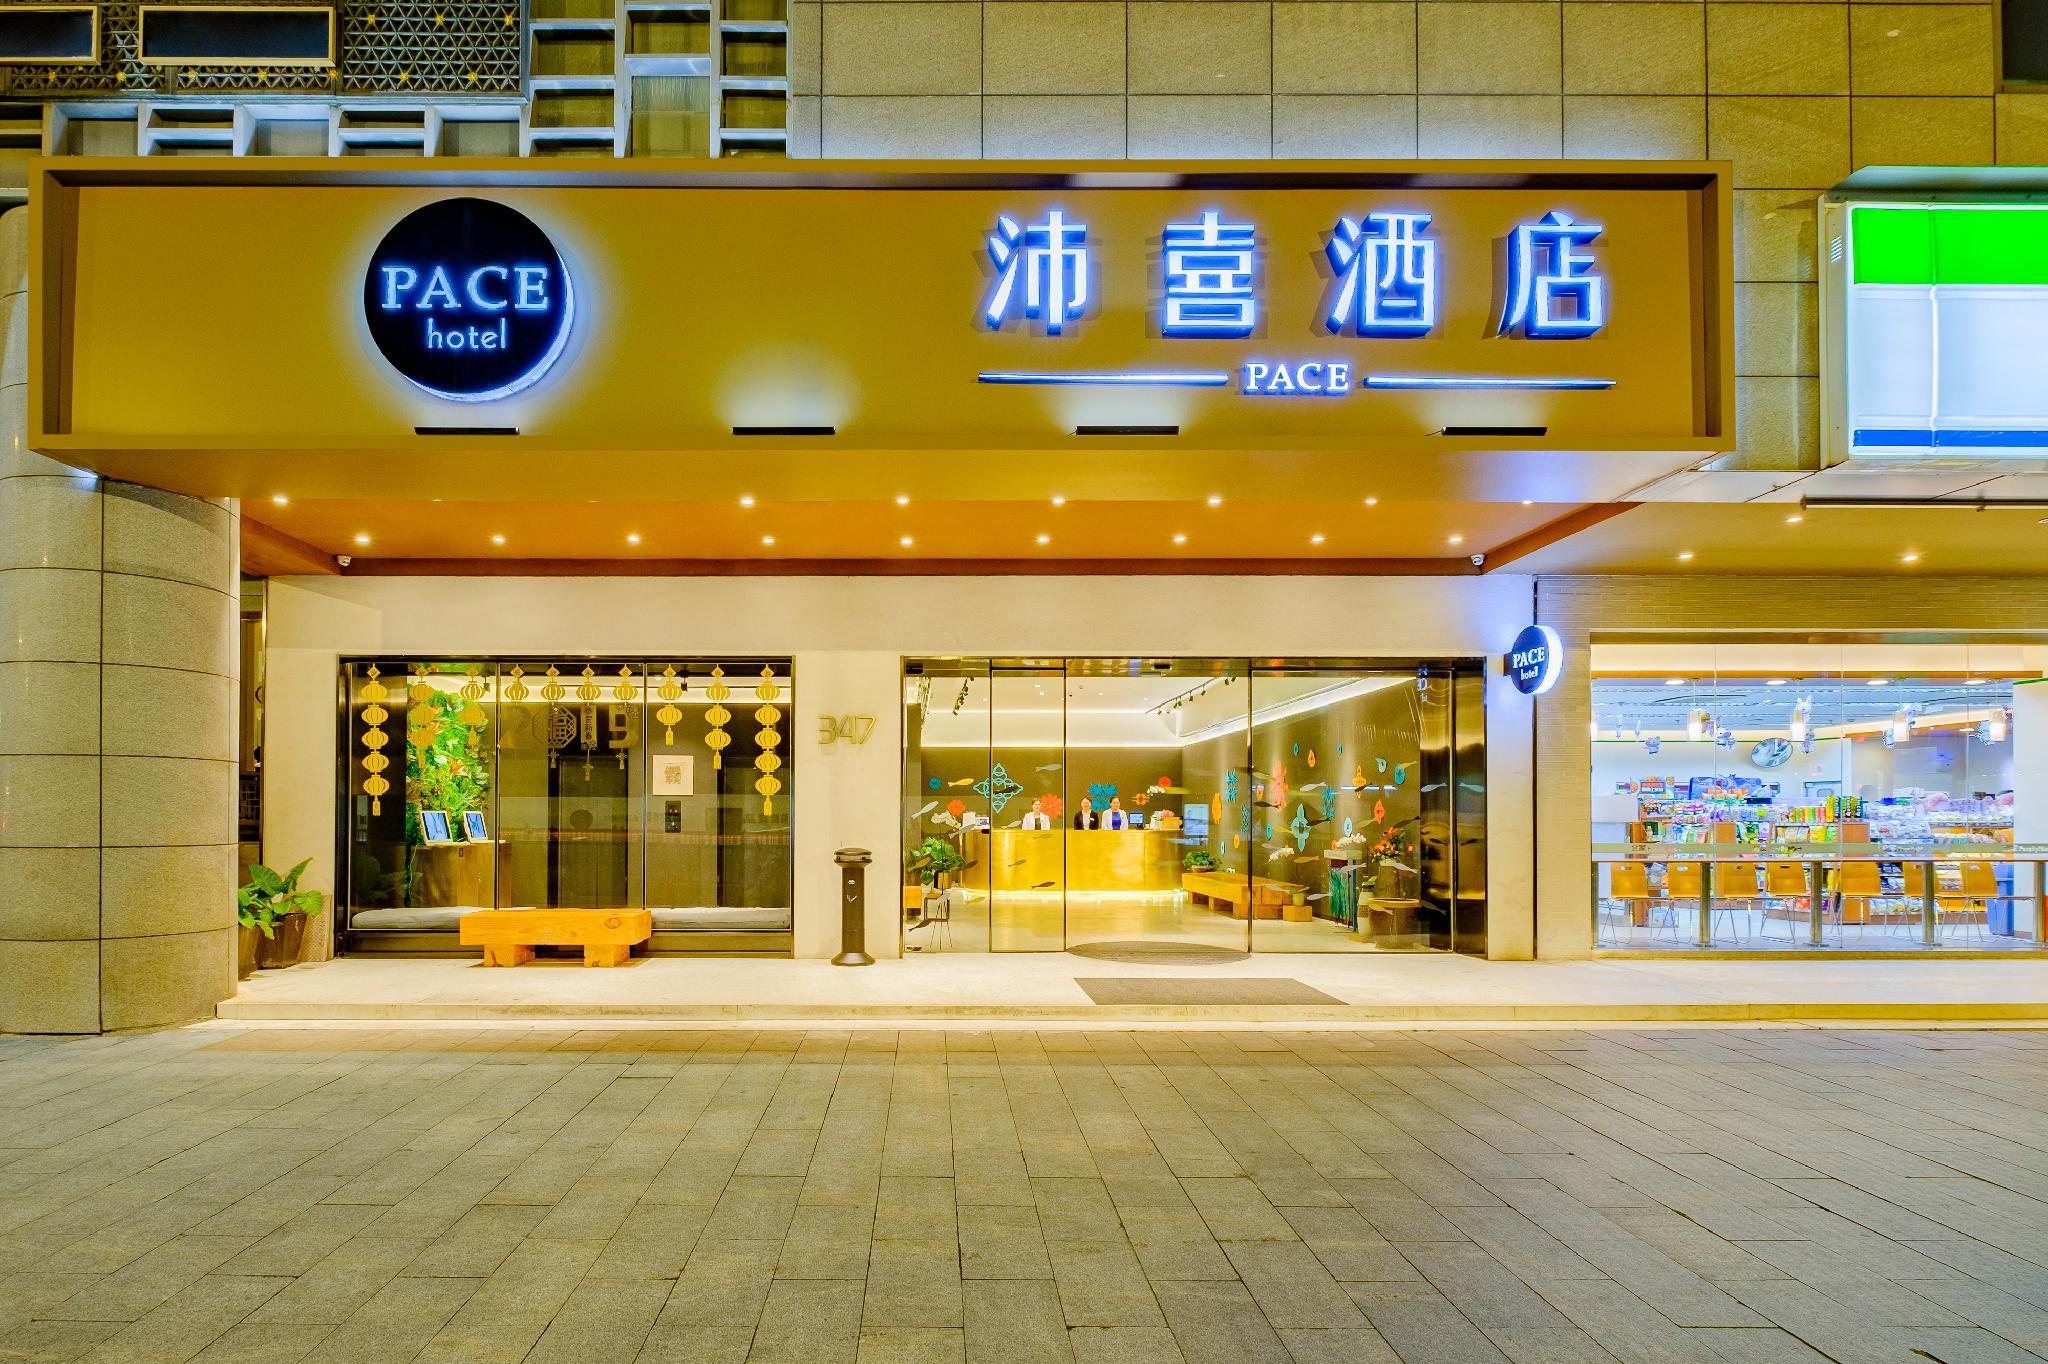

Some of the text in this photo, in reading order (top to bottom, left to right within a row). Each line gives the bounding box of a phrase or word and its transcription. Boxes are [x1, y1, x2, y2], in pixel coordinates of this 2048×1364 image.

[382, 266, 548, 310] PACE
[986, 210, 1604, 337] 沛喜酒店
[428, 317, 506, 349] hotel
[1246, 363, 1349, 391] PACE
[1512, 646, 1545, 669] PACE
[1520, 665, 1539, 680] hotel
[818, 714, 876, 745] 347
